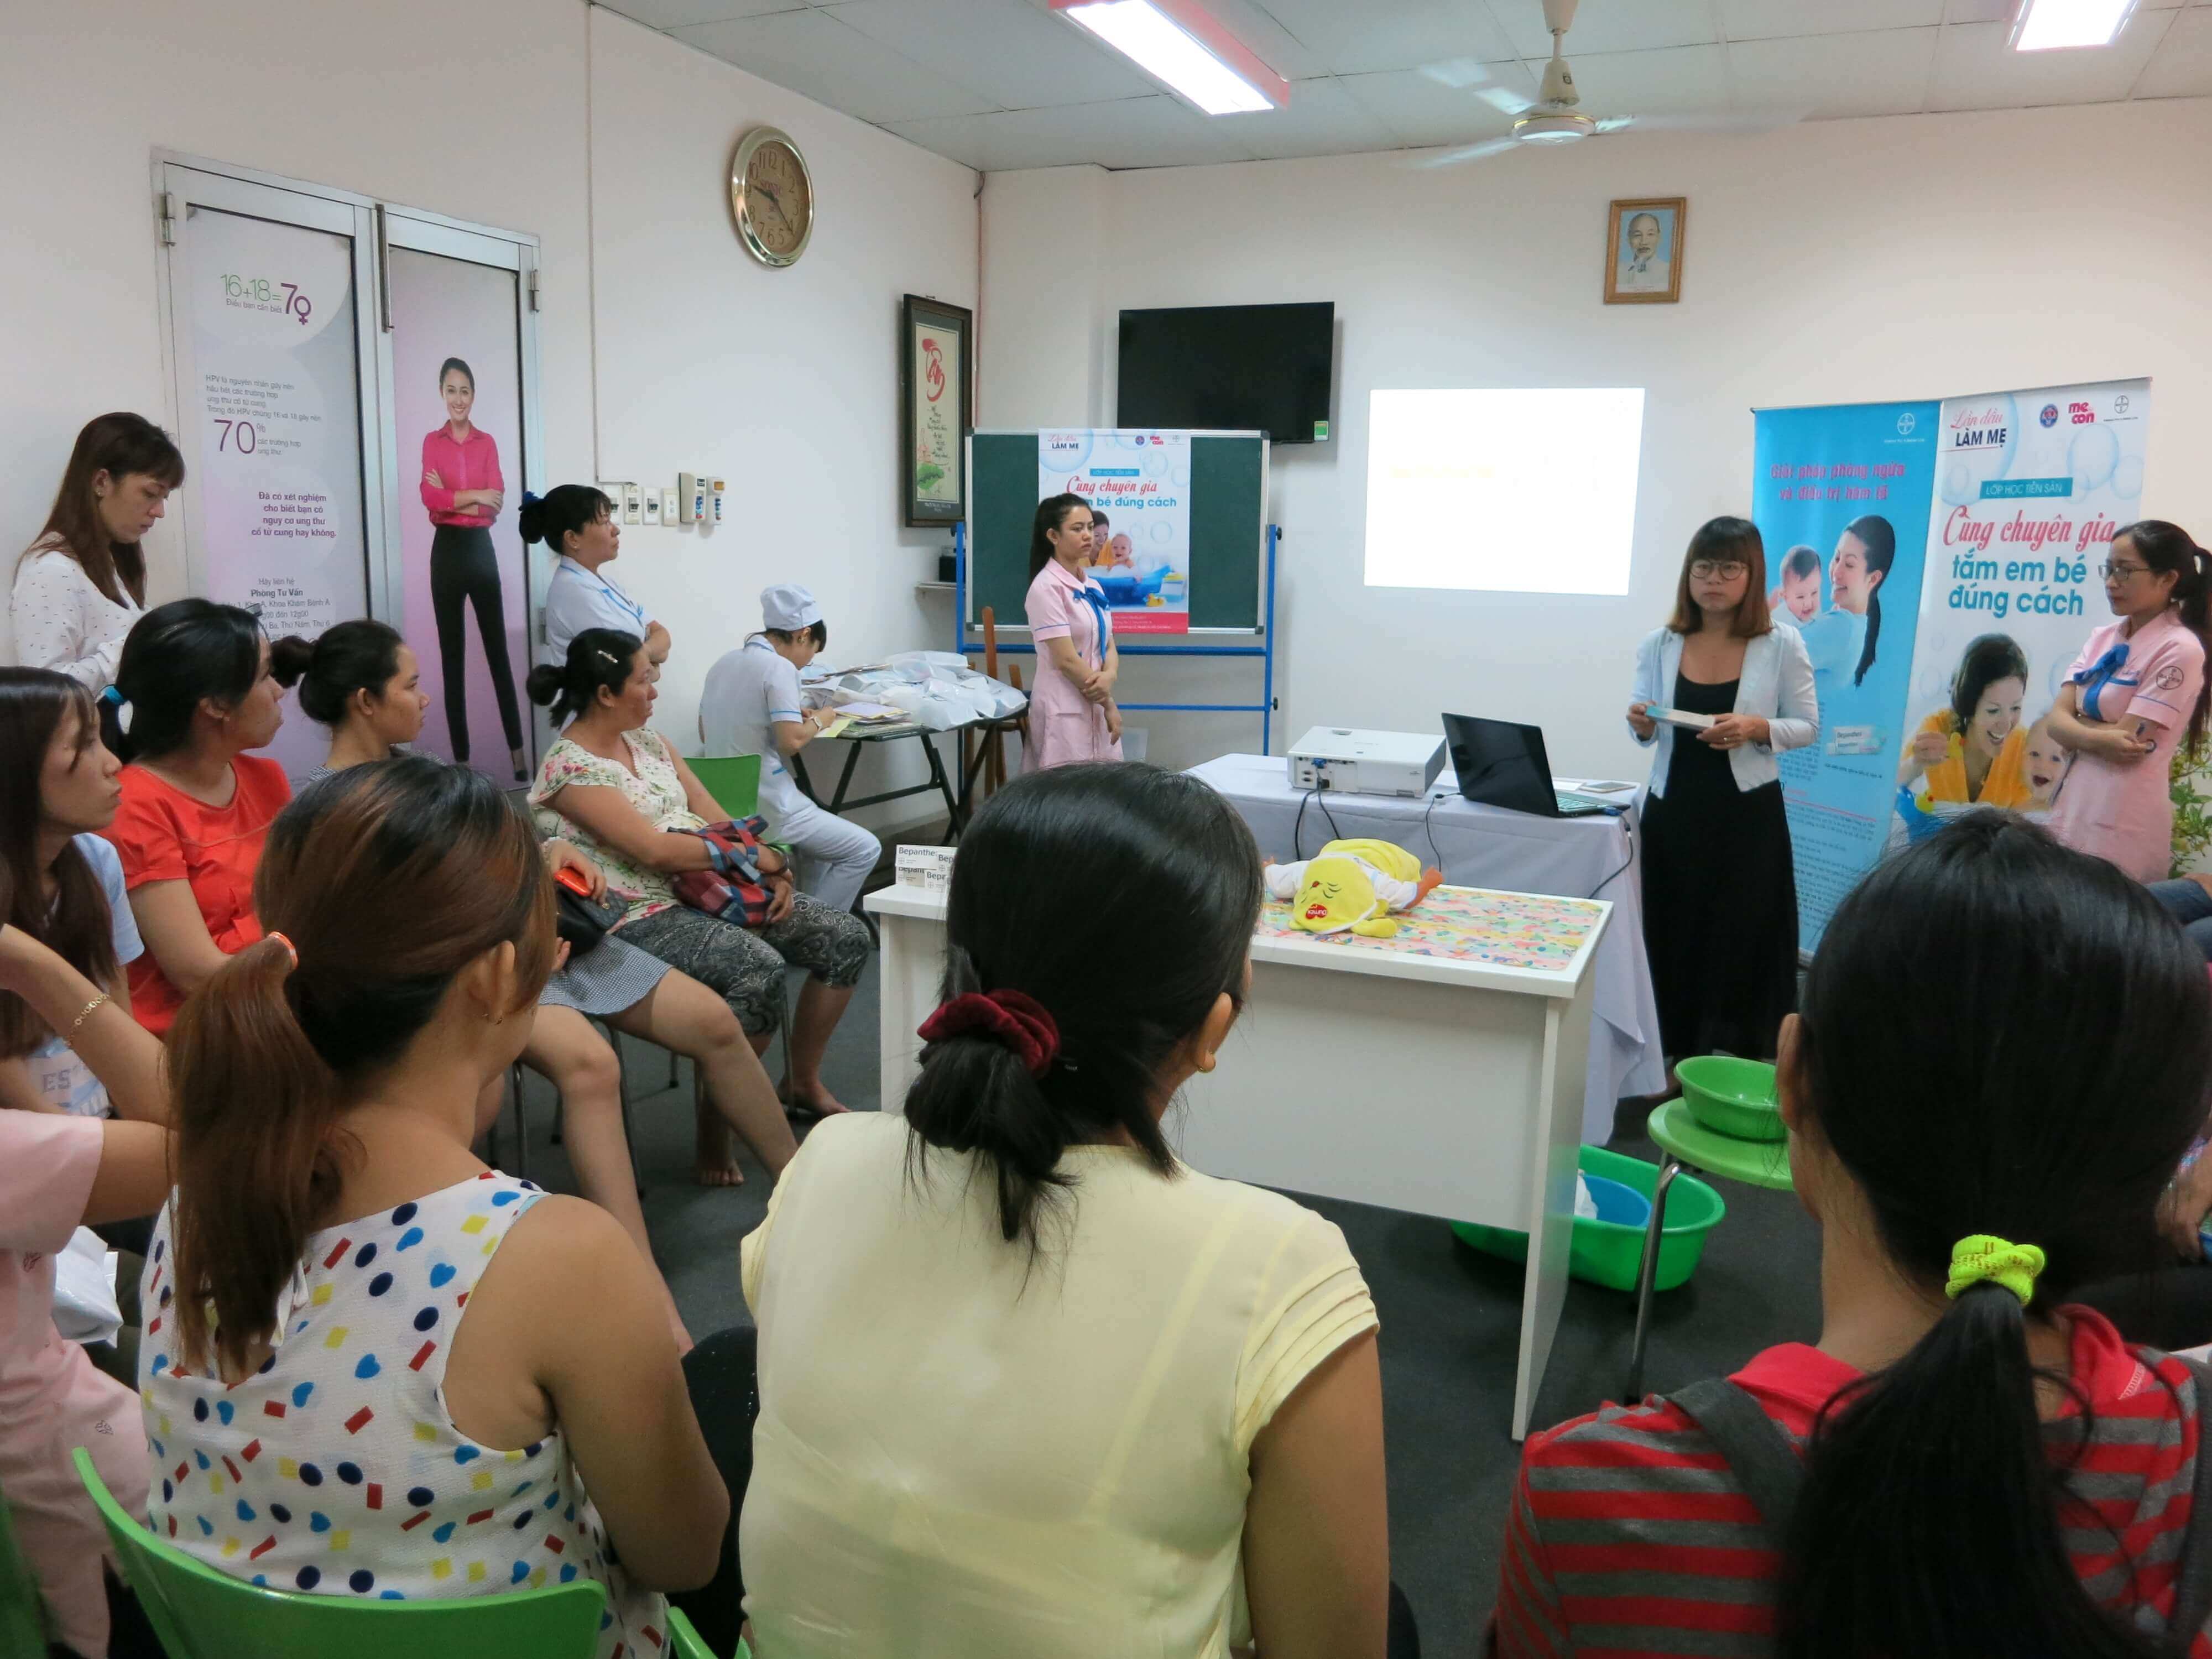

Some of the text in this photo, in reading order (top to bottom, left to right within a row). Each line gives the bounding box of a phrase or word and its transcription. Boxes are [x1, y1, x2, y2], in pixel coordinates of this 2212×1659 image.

[2068, 402, 2089, 414] me
[2071, 413, 2095, 424] con
[214, 419, 255, 454] 70
[1955, 427, 2007, 447] LÀM MẸ
[1099, 478, 1136, 495] chuyên
[1139, 479, 1157, 496] gia
[1097, 496, 1112, 507] bé
[1115, 496, 1144, 509] đúng
[1147, 496, 1177, 507] cách
[263, 517, 282, 525] nguy
[1943, 505, 2116, 552] Cùng chuyên gia
[274, 529, 294, 538] cung
[296, 529, 309, 538] hay
[1953, 547, 2087, 584] tắm em bé
[1948, 582, 2084, 618] đúng cách
